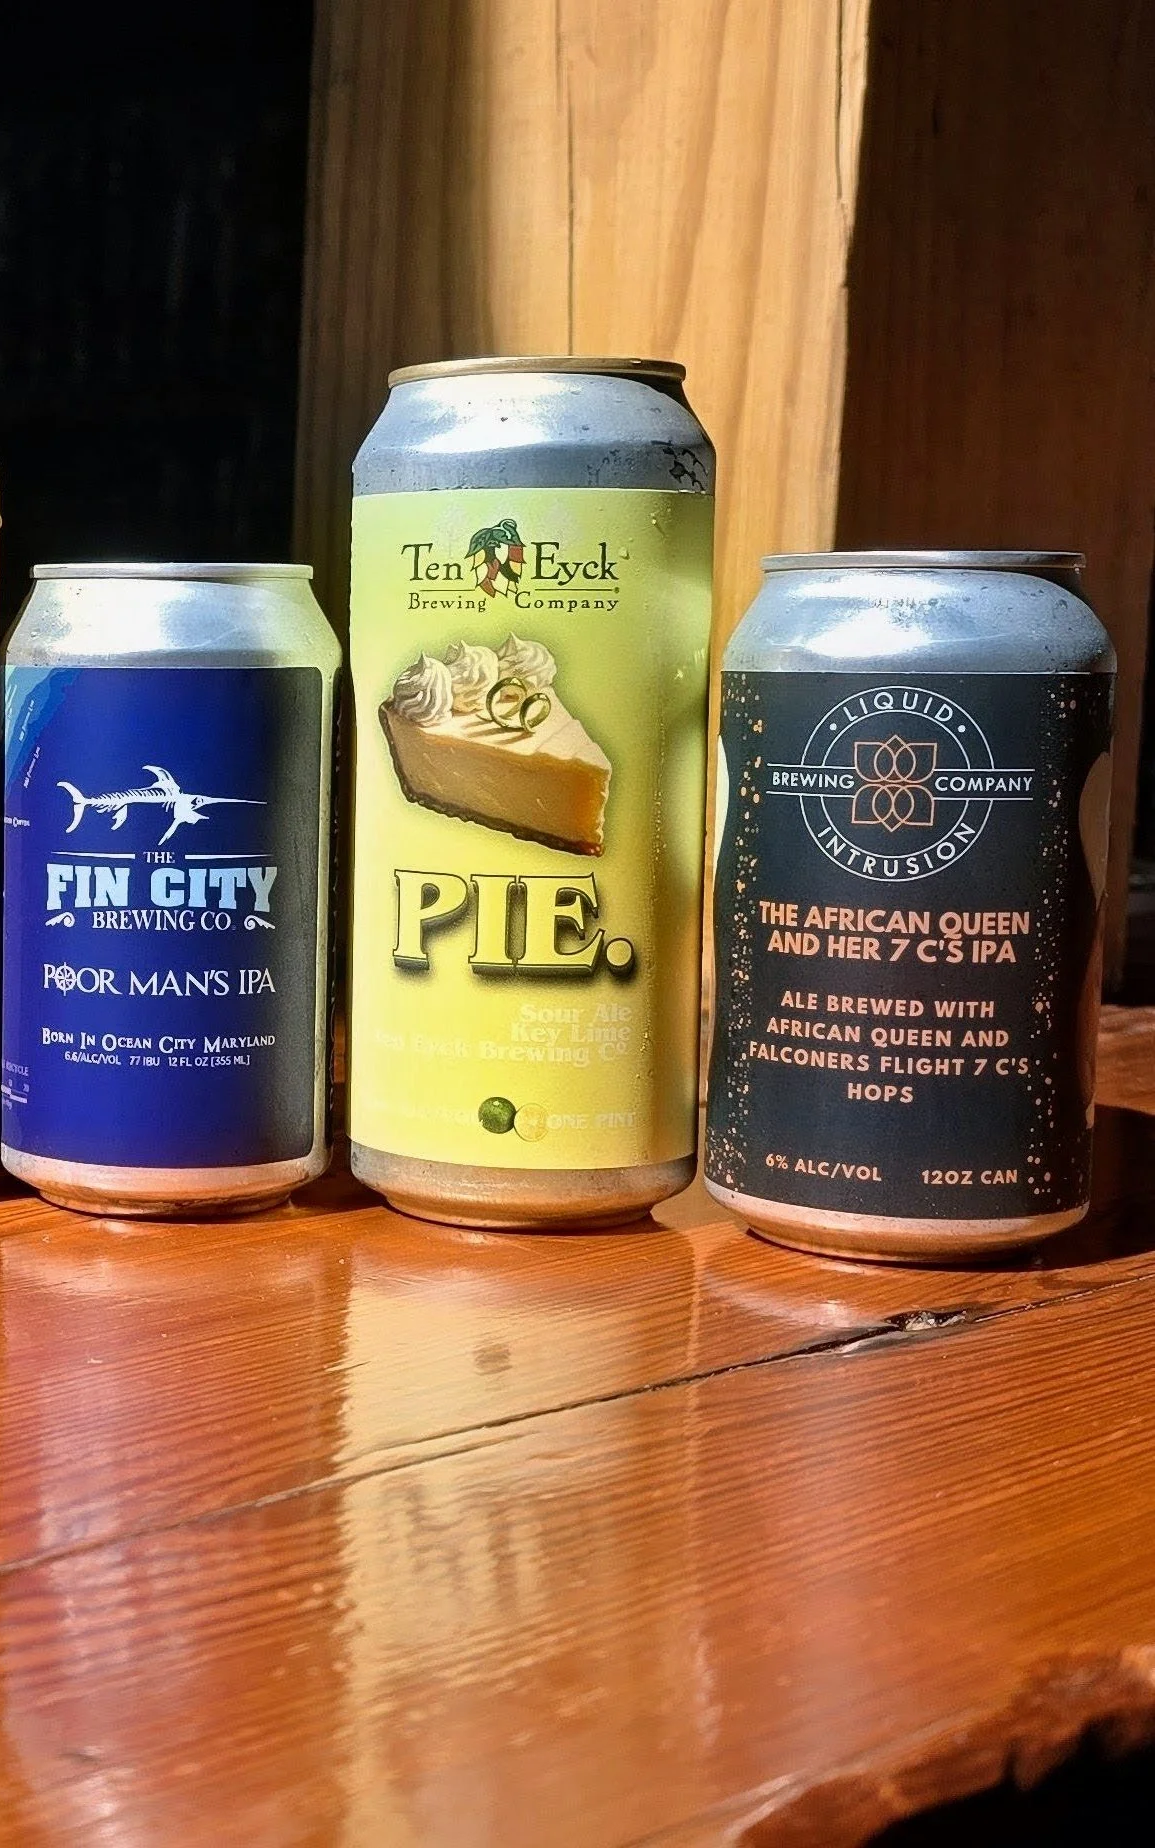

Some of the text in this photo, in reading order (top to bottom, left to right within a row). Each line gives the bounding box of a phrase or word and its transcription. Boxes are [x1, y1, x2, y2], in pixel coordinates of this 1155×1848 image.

[401, 541, 619, 587] Ten Eyck
[408, 590, 619, 612] Brewing Company
[842, 691, 954, 724] LIQUID
[772, 771, 1034, 793] BREWING COMPANY
[143, 851, 176, 864] THE
[817, 821, 977, 877] INTRUSION
[46, 863, 277, 912] FIN CITY
[92, 909, 195, 931] BREWING
[392, 868, 636, 976] PIE.
[759, 901, 1030, 940] THE AFRICAN QUEEN
[767, 930, 1017, 963] AND HER 7 C'S IPA
[128, 969, 230, 997] MAN'S
[239, 967, 276, 995] IPA
[518, 1001, 632, 1024] Sour Ale
[781, 990, 996, 1019] ALE BREWED WITH
[511, 1022, 632, 1047] Key Lime
[766, 1017, 1010, 1049] AFRICAN QUEEN AND
[143, 1056, 160, 1066] IBU
[168, 1056, 178, 1067] 12
[179, 1056, 192, 1067] FL
[194, 1056, 209, 1067] OZ
[480, 1041, 590, 1068] Brewing
[749, 1041, 1030, 1076] FALCONERS FLIGHT 7 C'S
[847, 1082, 914, 1104] HOPS
[765, 1152, 1018, 1186] 6% ALC/VOL 12OZ CAN
